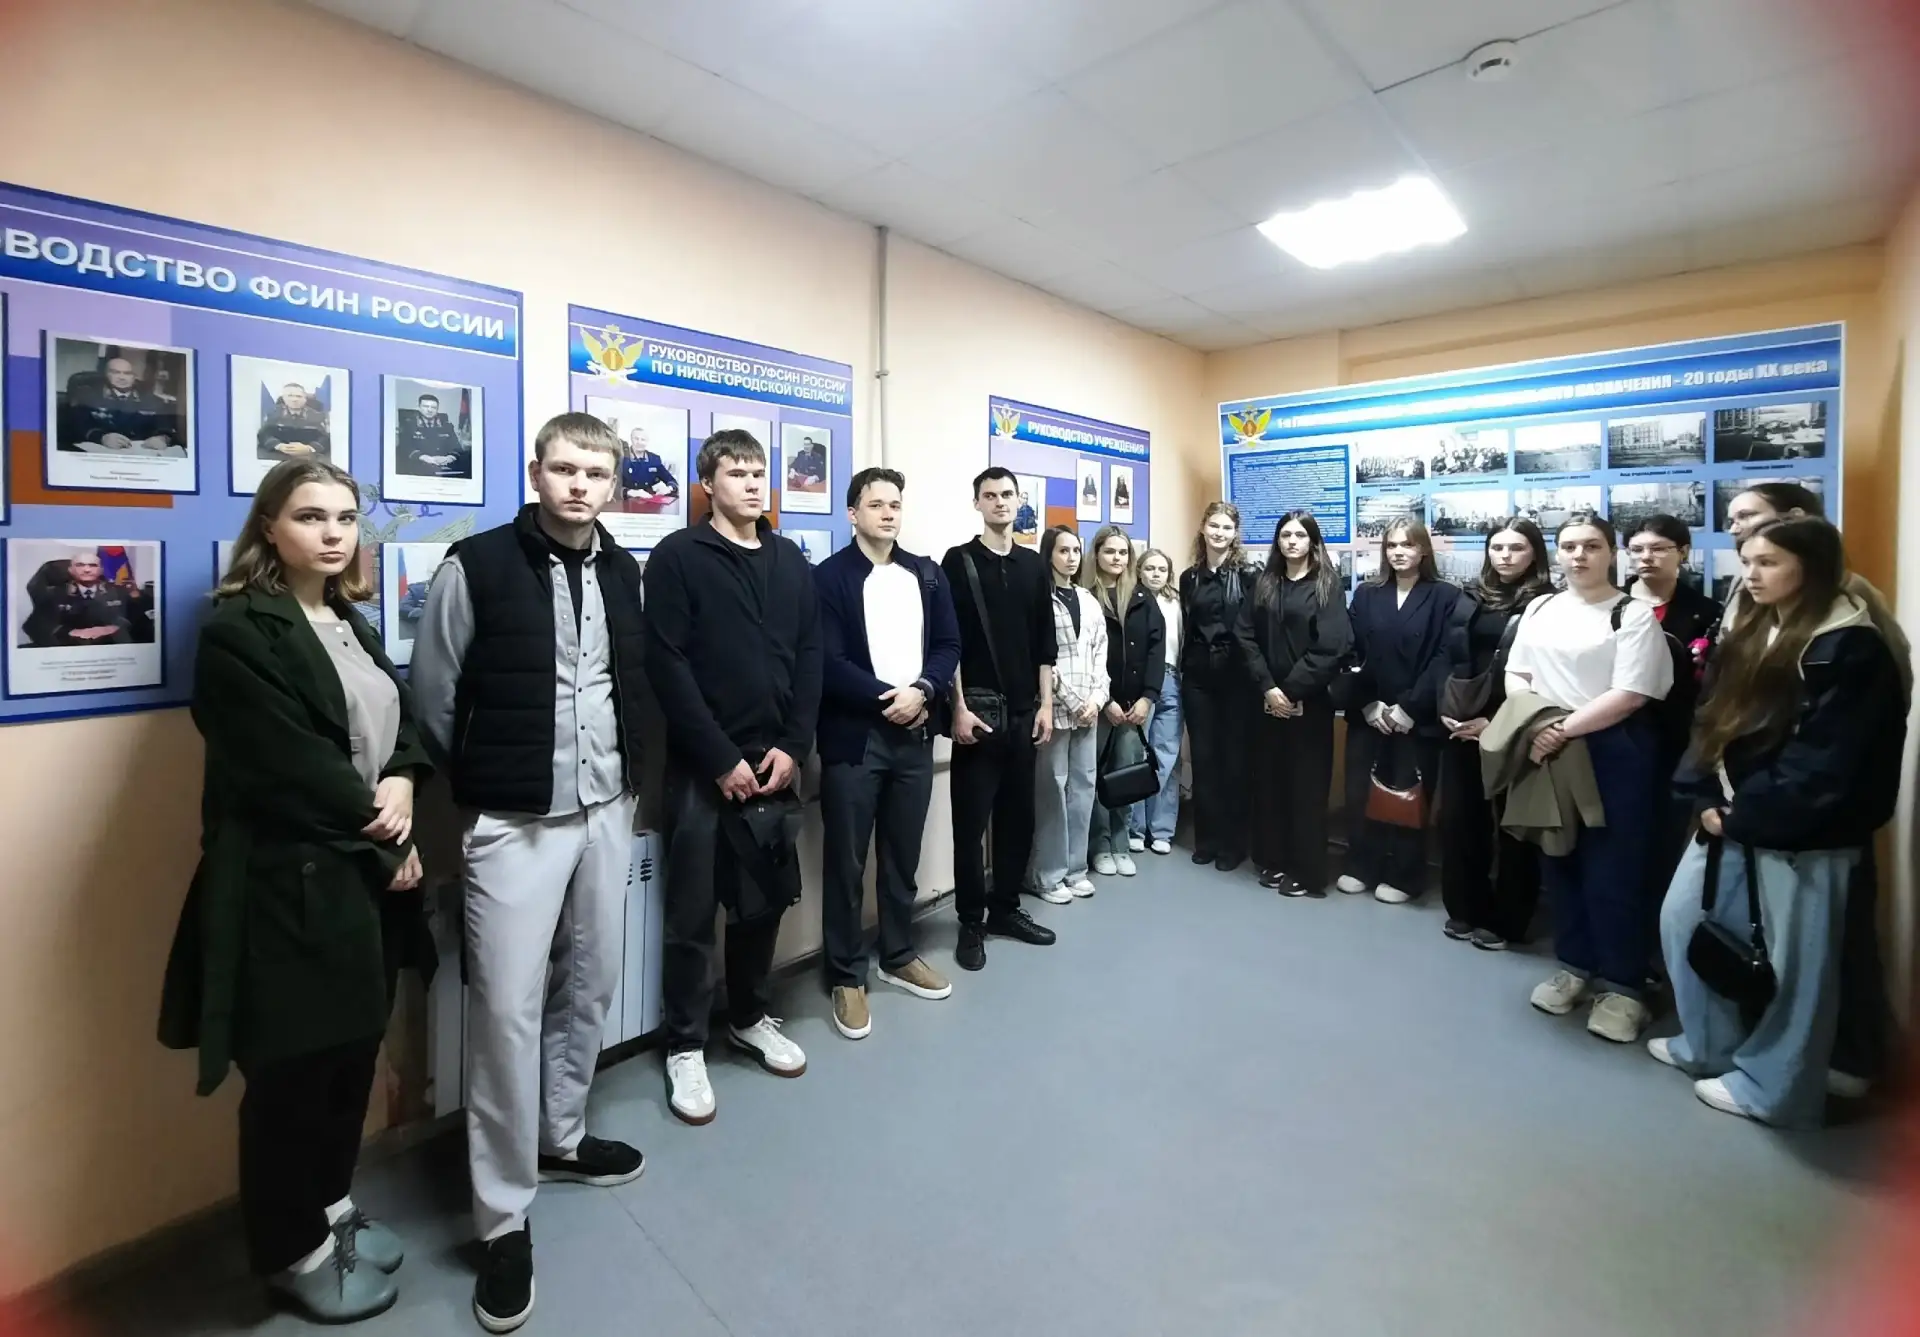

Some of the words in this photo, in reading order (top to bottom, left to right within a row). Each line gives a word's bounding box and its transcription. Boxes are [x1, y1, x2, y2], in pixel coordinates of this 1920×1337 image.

[0, 226, 237, 294] ВОДСТВО
[249, 273, 360, 315] ФСИН
[371, 296, 506, 341] РОССИИ
[649, 344, 751, 375] РУКОВОДСТВО
[753, 365, 800, 384] ГУФСИН
[803, 374, 846, 393] РОССИИ
[652, 360, 673, 375] ПО
[677, 365, 792, 396] НИЖЕГОРОДСКОЙ
[794, 386, 844, 405] ОБЛАСТИ
[1684, 371, 1704, 386] 20
[1708, 368, 1754, 384] годы
[1780, 360, 1828, 375] века
[1028, 421, 1093, 446] РУКОВОДСТВО
[1094, 435, 1144, 456] УЧРЕЖДЕНИЯ
